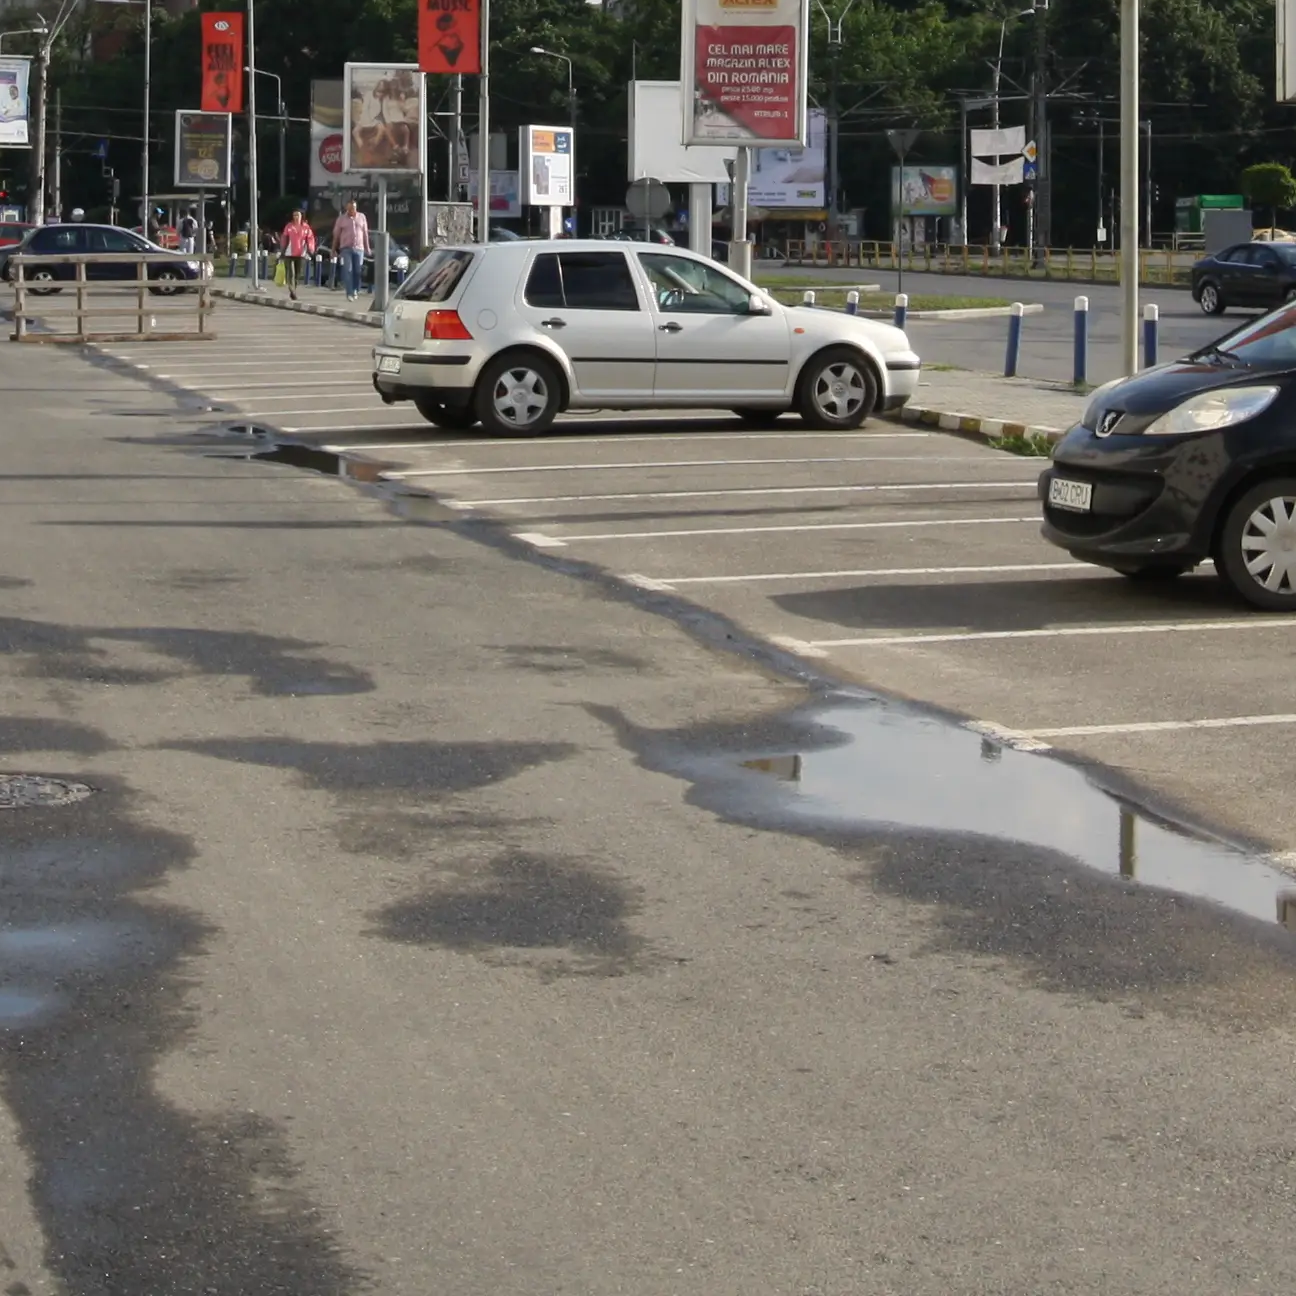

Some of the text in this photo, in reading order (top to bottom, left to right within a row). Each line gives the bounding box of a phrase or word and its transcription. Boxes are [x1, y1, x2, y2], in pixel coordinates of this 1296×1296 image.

[708, 44, 789, 55] CEL MAI MARE
[706, 58, 790, 68] MAGAZIN ALTEX
[707, 70, 789, 83] DIN ROMÂNIA
